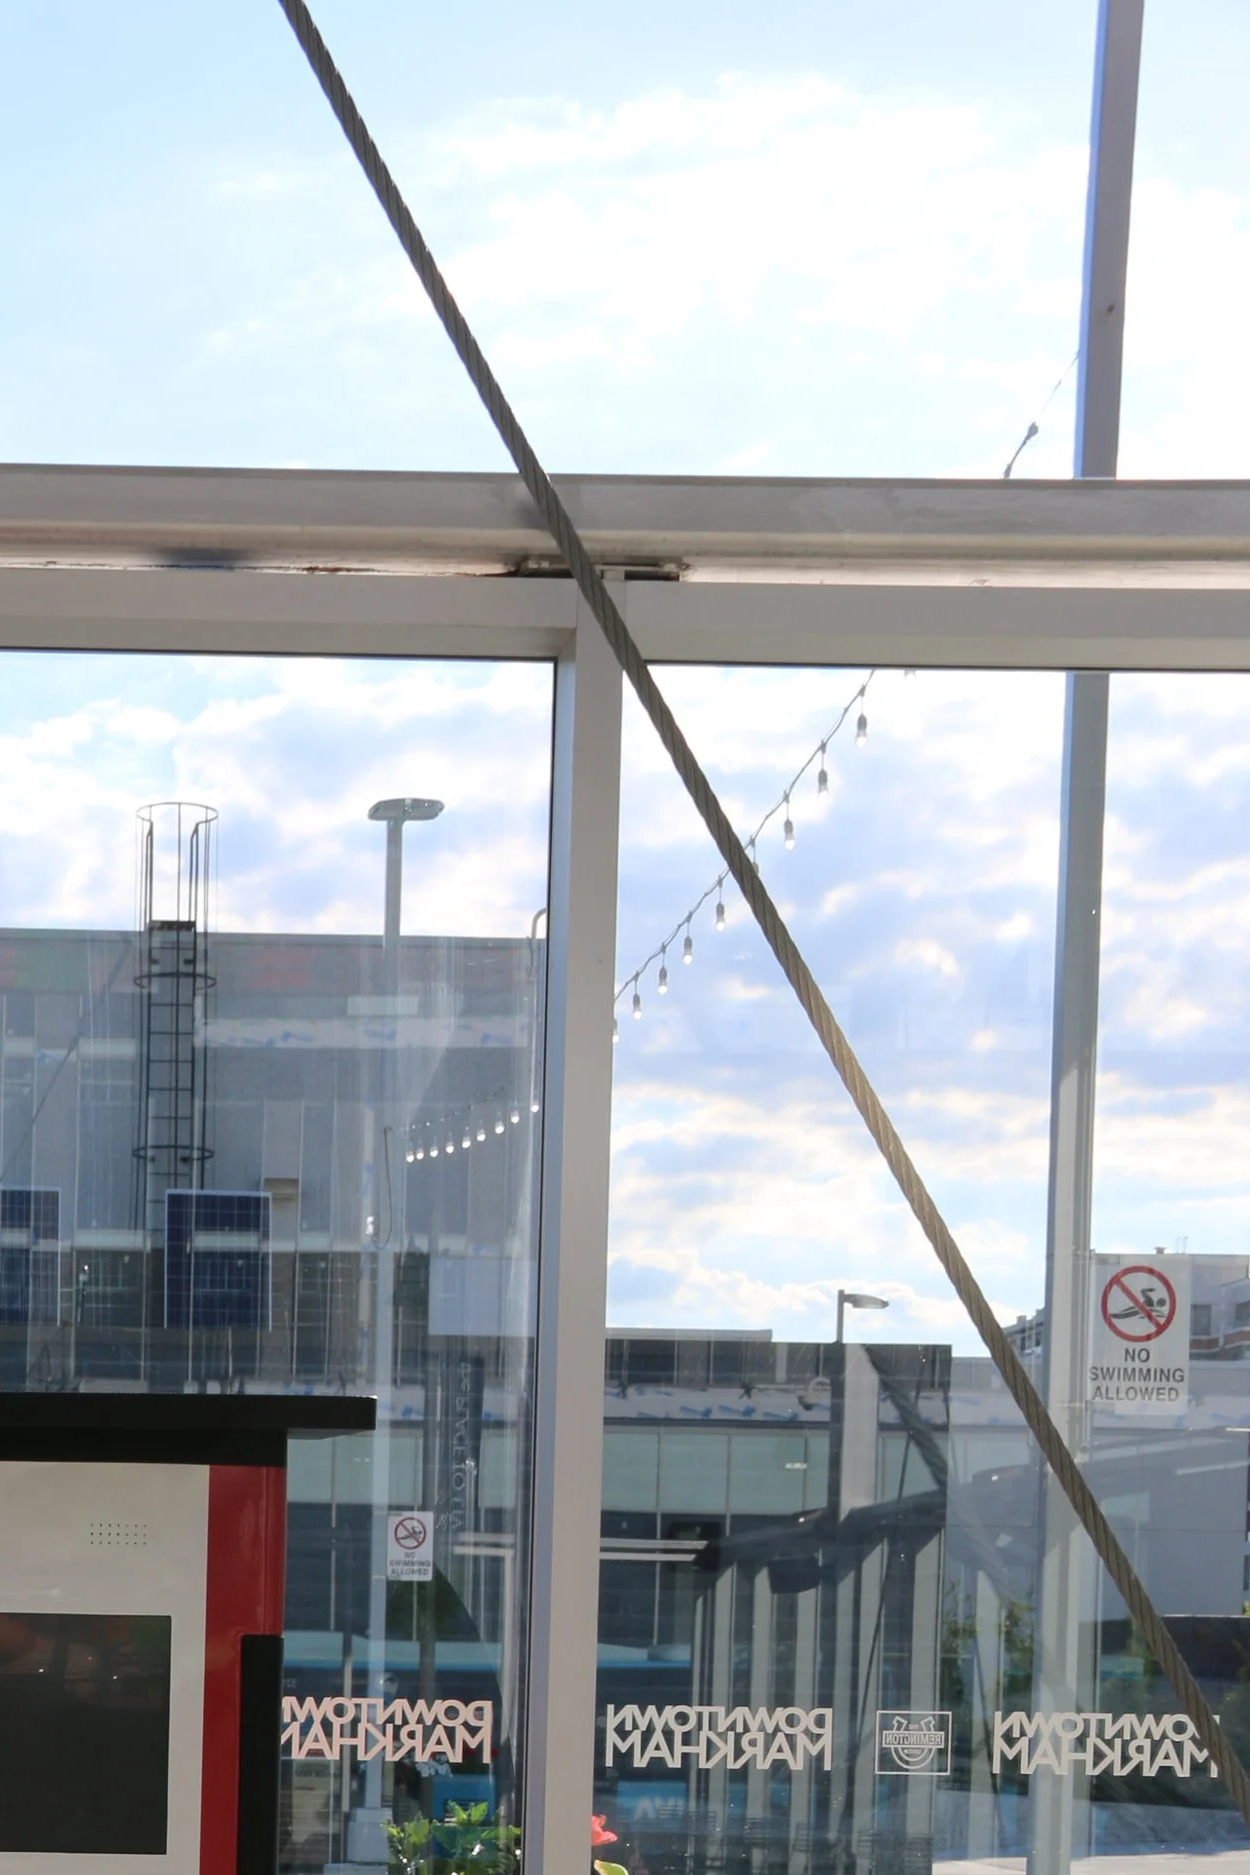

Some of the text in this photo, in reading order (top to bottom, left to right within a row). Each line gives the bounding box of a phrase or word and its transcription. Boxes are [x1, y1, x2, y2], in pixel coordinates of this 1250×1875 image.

[1124, 1347, 1151, 1364] NO
[1089, 1366, 1185, 1384] SWIMMING
[1091, 1385, 1180, 1403] ALLOWED
